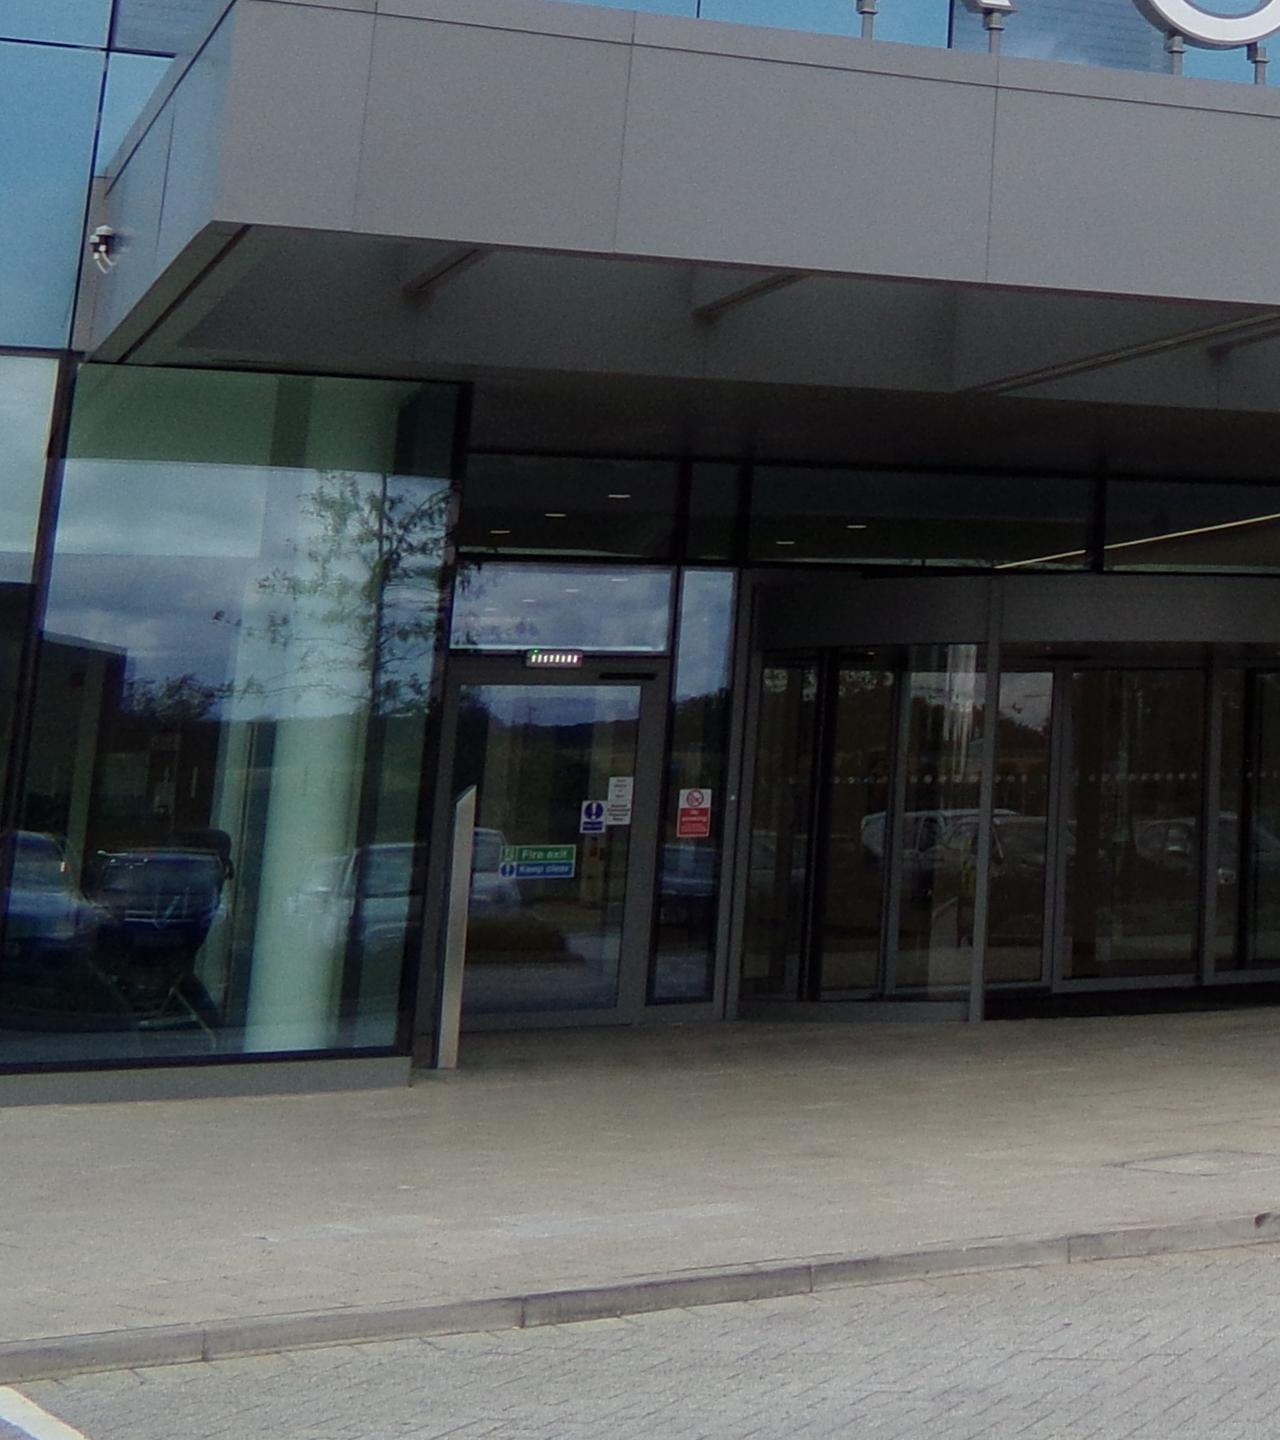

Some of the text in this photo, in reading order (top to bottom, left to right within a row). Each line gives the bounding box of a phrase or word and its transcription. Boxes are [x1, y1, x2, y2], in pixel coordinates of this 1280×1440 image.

[521, 848, 570, 859] Fire exit
[519, 864, 570, 874] Keep clear
